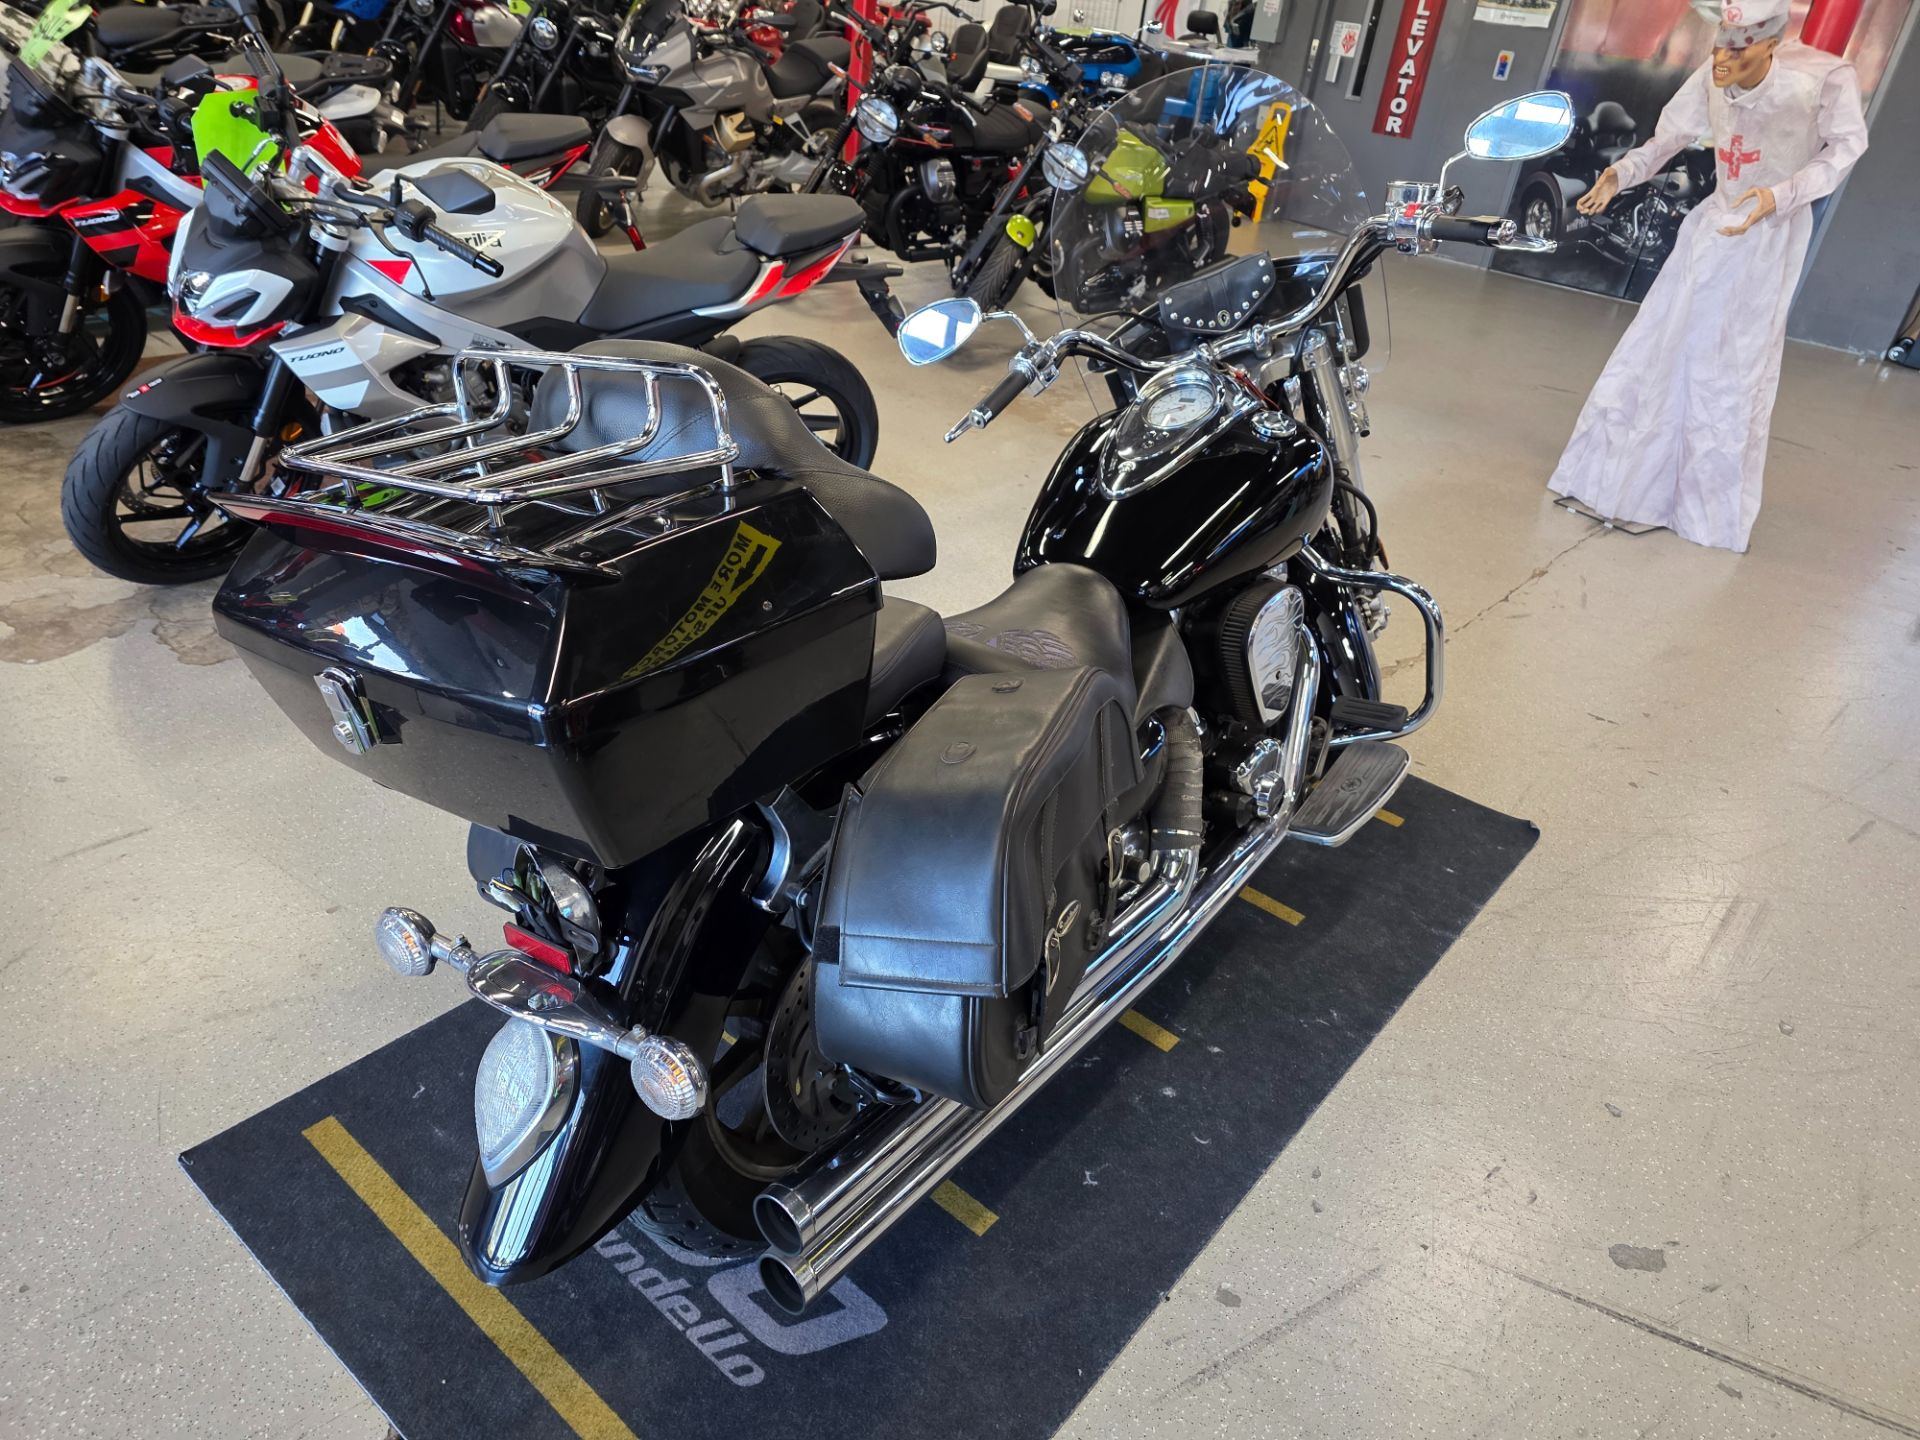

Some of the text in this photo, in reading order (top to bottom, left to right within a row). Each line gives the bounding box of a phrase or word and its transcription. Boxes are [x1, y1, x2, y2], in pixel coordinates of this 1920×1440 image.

[1384, 0, 1431, 134] LEVATOR
[463, 231, 503, 248] rilia
[289, 346, 345, 363] TUONO
